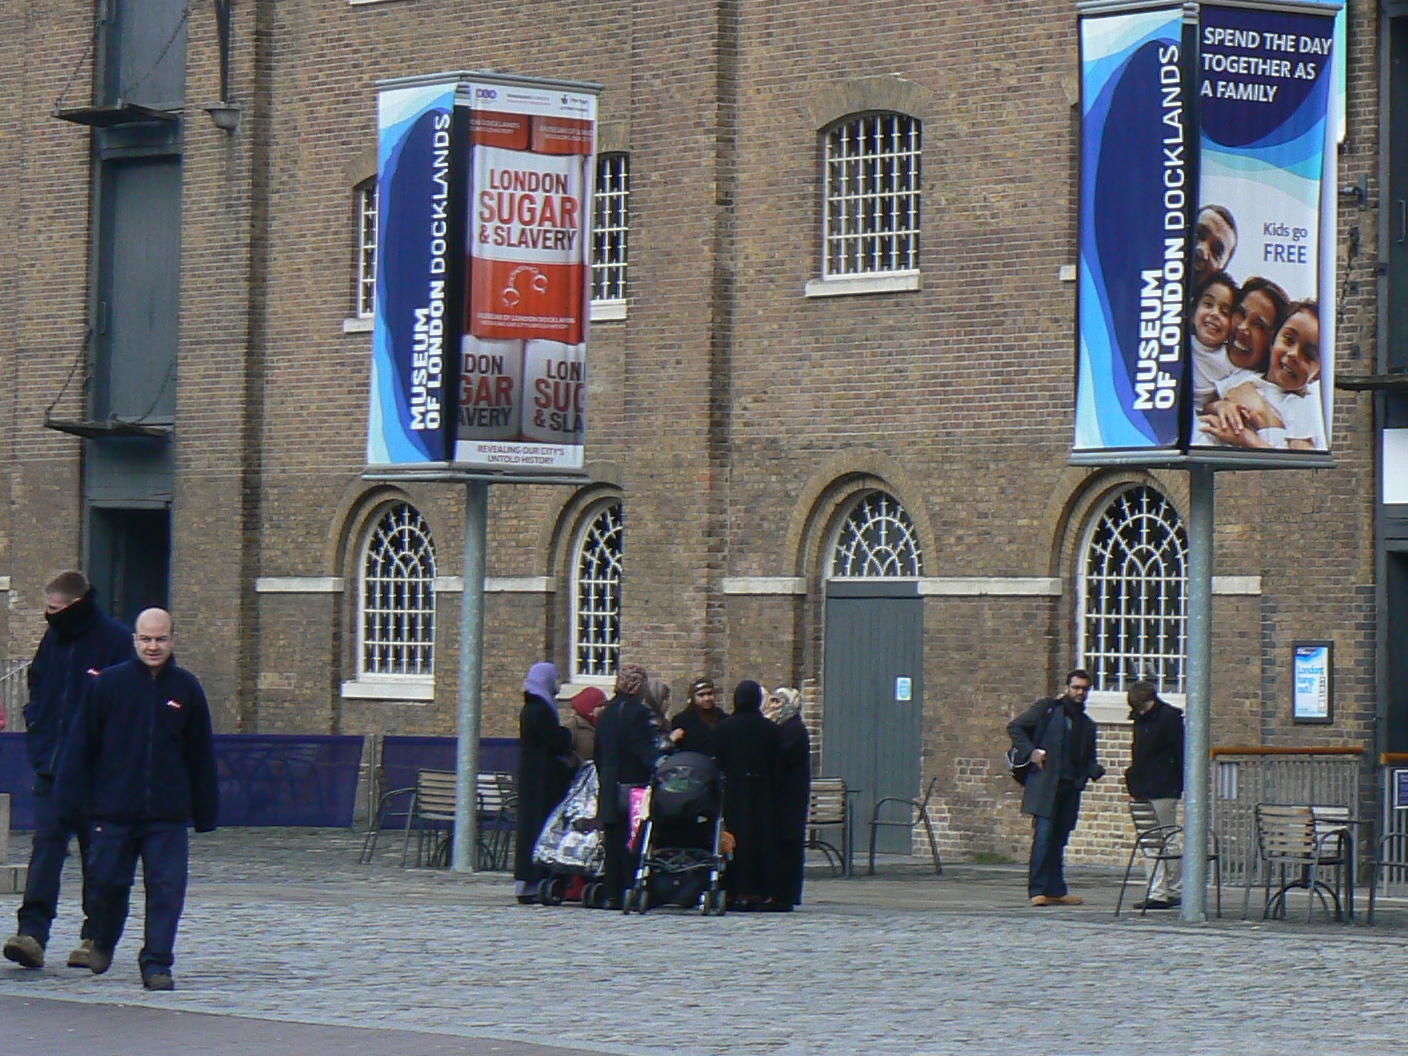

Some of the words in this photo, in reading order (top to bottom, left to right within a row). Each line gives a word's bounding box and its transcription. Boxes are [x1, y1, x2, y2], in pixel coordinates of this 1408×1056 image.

[1203, 26, 1260, 49] SPEND
[1263, 33, 1296, 52] THE
[1300, 36, 1333, 55] DAY
[1202, 53, 1291, 78] TOGETHER
[1293, 61, 1317, 80] AS
[1200, 80, 1213, 98] A
[1217, 80, 1278, 102] FAMILY
[1159, 45, 1185, 230] DOCKLANDS
[430, 113, 450, 274] DOCKLANDS
[490, 169, 568, 194] LONDON
[479, 190, 579, 228] SUGAR
[480, 224, 490, 244] &
[494, 225, 577, 250] SLAVERY
[1263, 222, 1290, 237] Kids
[1292, 227, 1308, 241] go
[1263, 243, 1307, 264] FREE
[1159, 237, 1185, 363] LONDON
[427, 280, 445, 388] LONDON
[1133, 269, 1163, 410] MUSEUM
[410, 308, 430, 430] MUSEUM
[1154, 370, 1178, 410] OF
[425, 396, 441, 430] OF
[534, 409, 546, 428] &
[478, 445, 521, 454] REVEALING
[522, 446, 540, 455] OUR
[541, 447, 565, 456] CITY'S
[487, 455, 520, 463] UNTOLD
[521, 456, 554, 465] HISTORY
